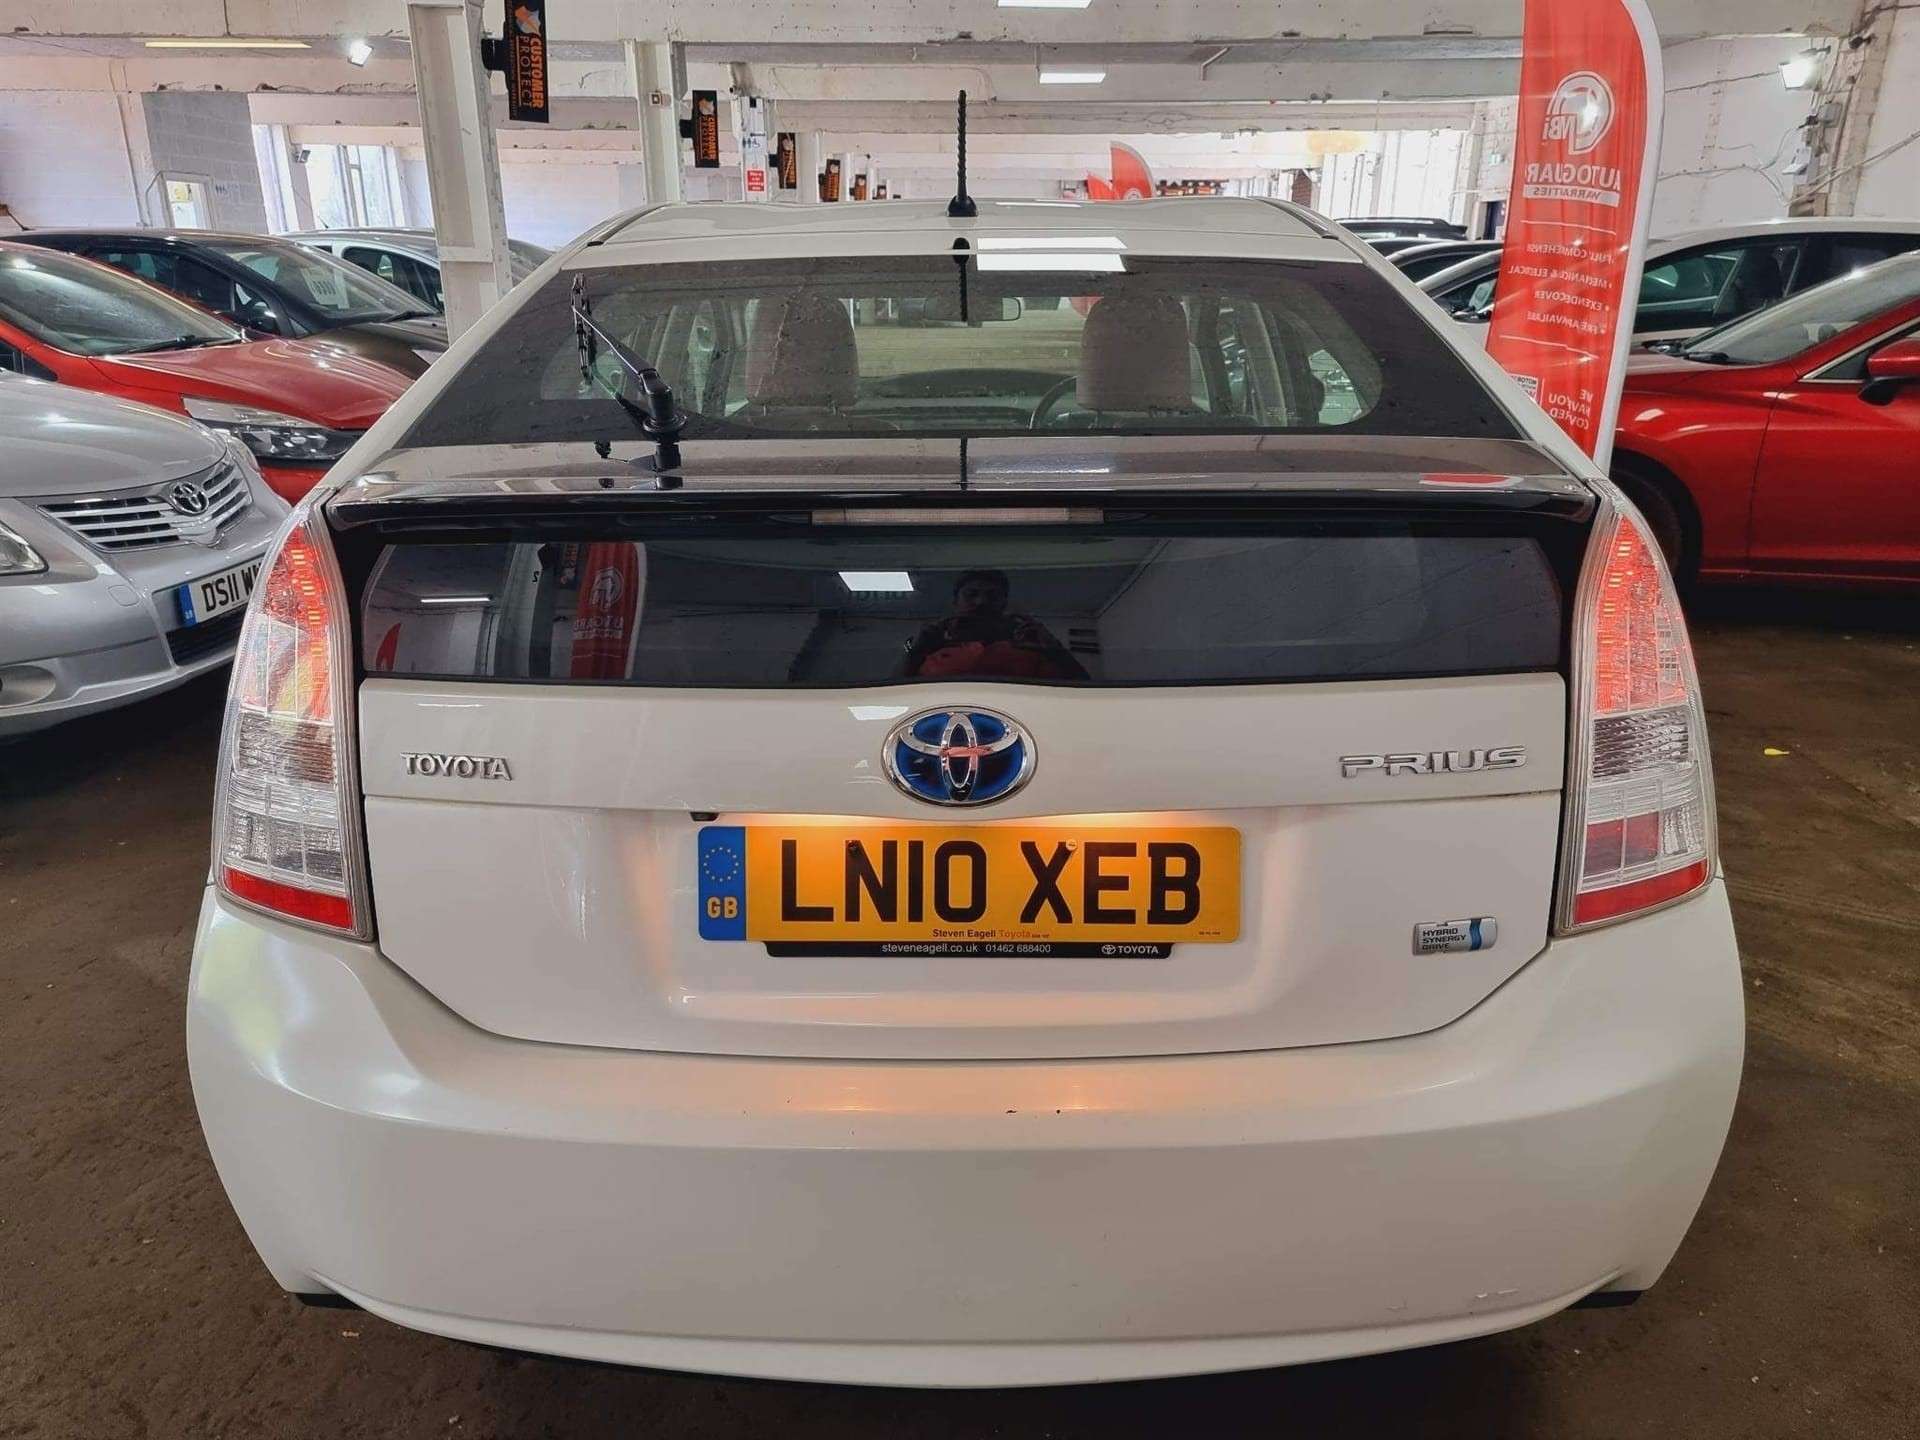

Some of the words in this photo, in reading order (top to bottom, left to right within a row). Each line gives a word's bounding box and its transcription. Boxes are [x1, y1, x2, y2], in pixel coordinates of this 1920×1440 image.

[519, 36, 532, 107] PROTECT
[530, 37, 546, 109] CUSTOMER
[400, 752, 513, 781] TOYOTA
[1339, 745, 1528, 778] PRIUS
[780, 838, 988, 924] LN10
[1019, 838, 1202, 925] XEB
[707, 896, 739, 919] GB
[932, 928, 965, 938] Steven
[967, 929, 996, 939] Eagell
[999, 929, 1031, 940] Toyota
[1422, 927, 1459, 937] HYBRID
[1422, 934, 1467, 944] SYNERGY
[881, 943, 979, 954] steveneagell.co.uk
[985, 944, 1014, 954] 01462
[1016, 944, 1052, 954] 688400
[1117, 944, 1159, 955] TOYOTA
